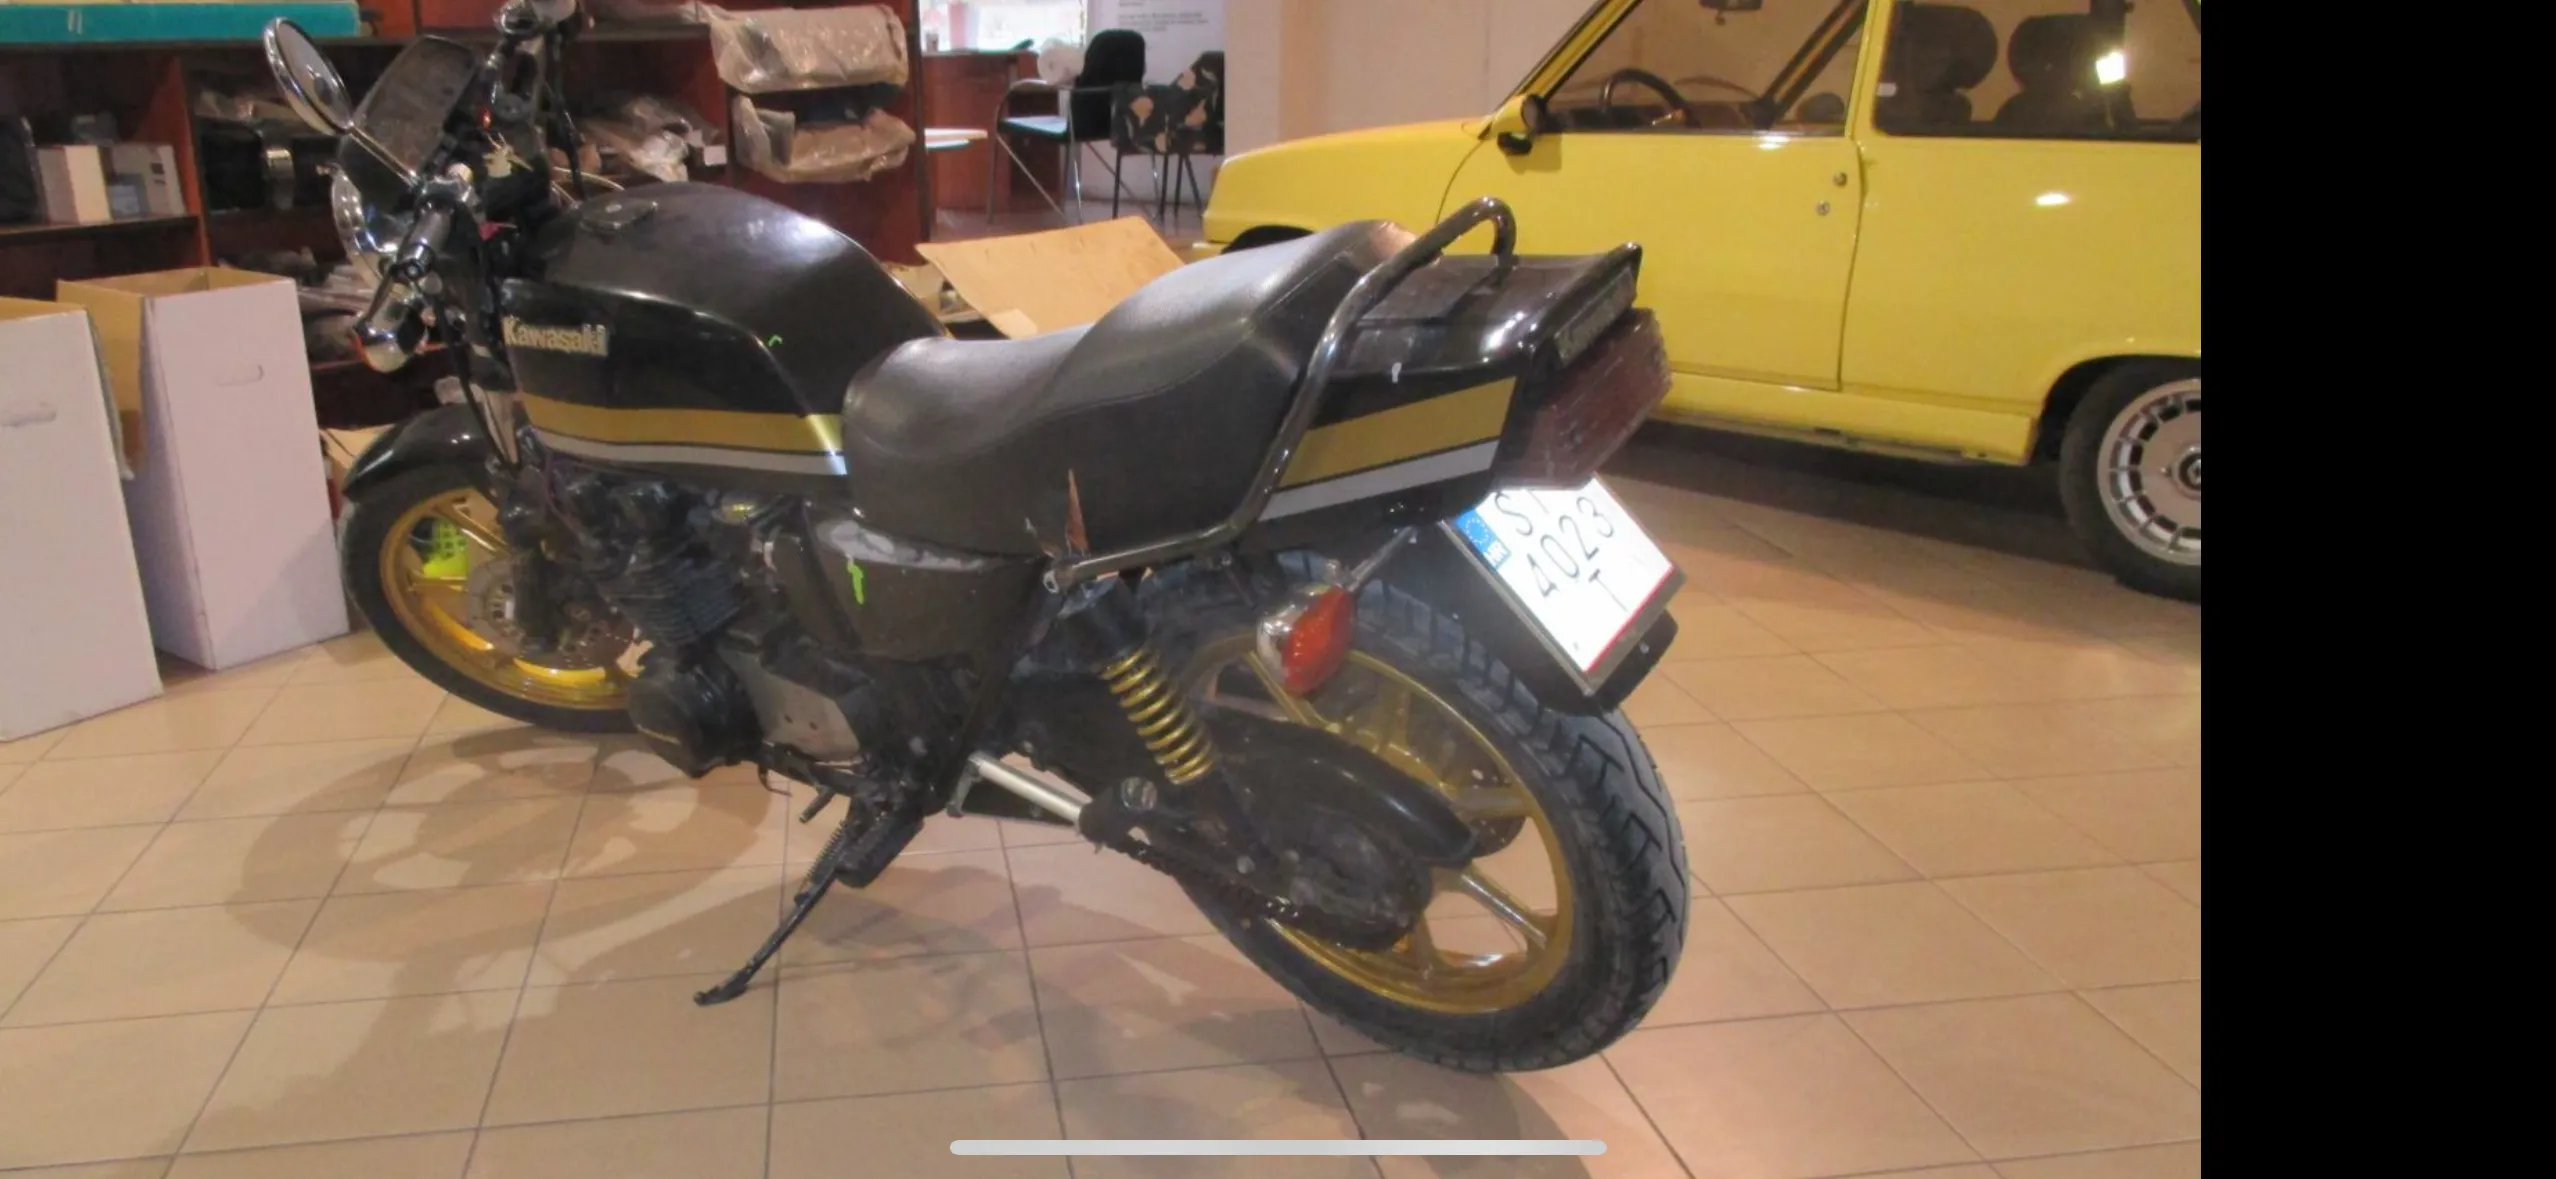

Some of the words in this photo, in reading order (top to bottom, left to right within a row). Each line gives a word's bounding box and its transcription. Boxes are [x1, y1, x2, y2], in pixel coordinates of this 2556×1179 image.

[502, 316, 608, 356] Kawasaki
[1526, 496, 1614, 597] 4023
[1588, 568, 1629, 612] T
